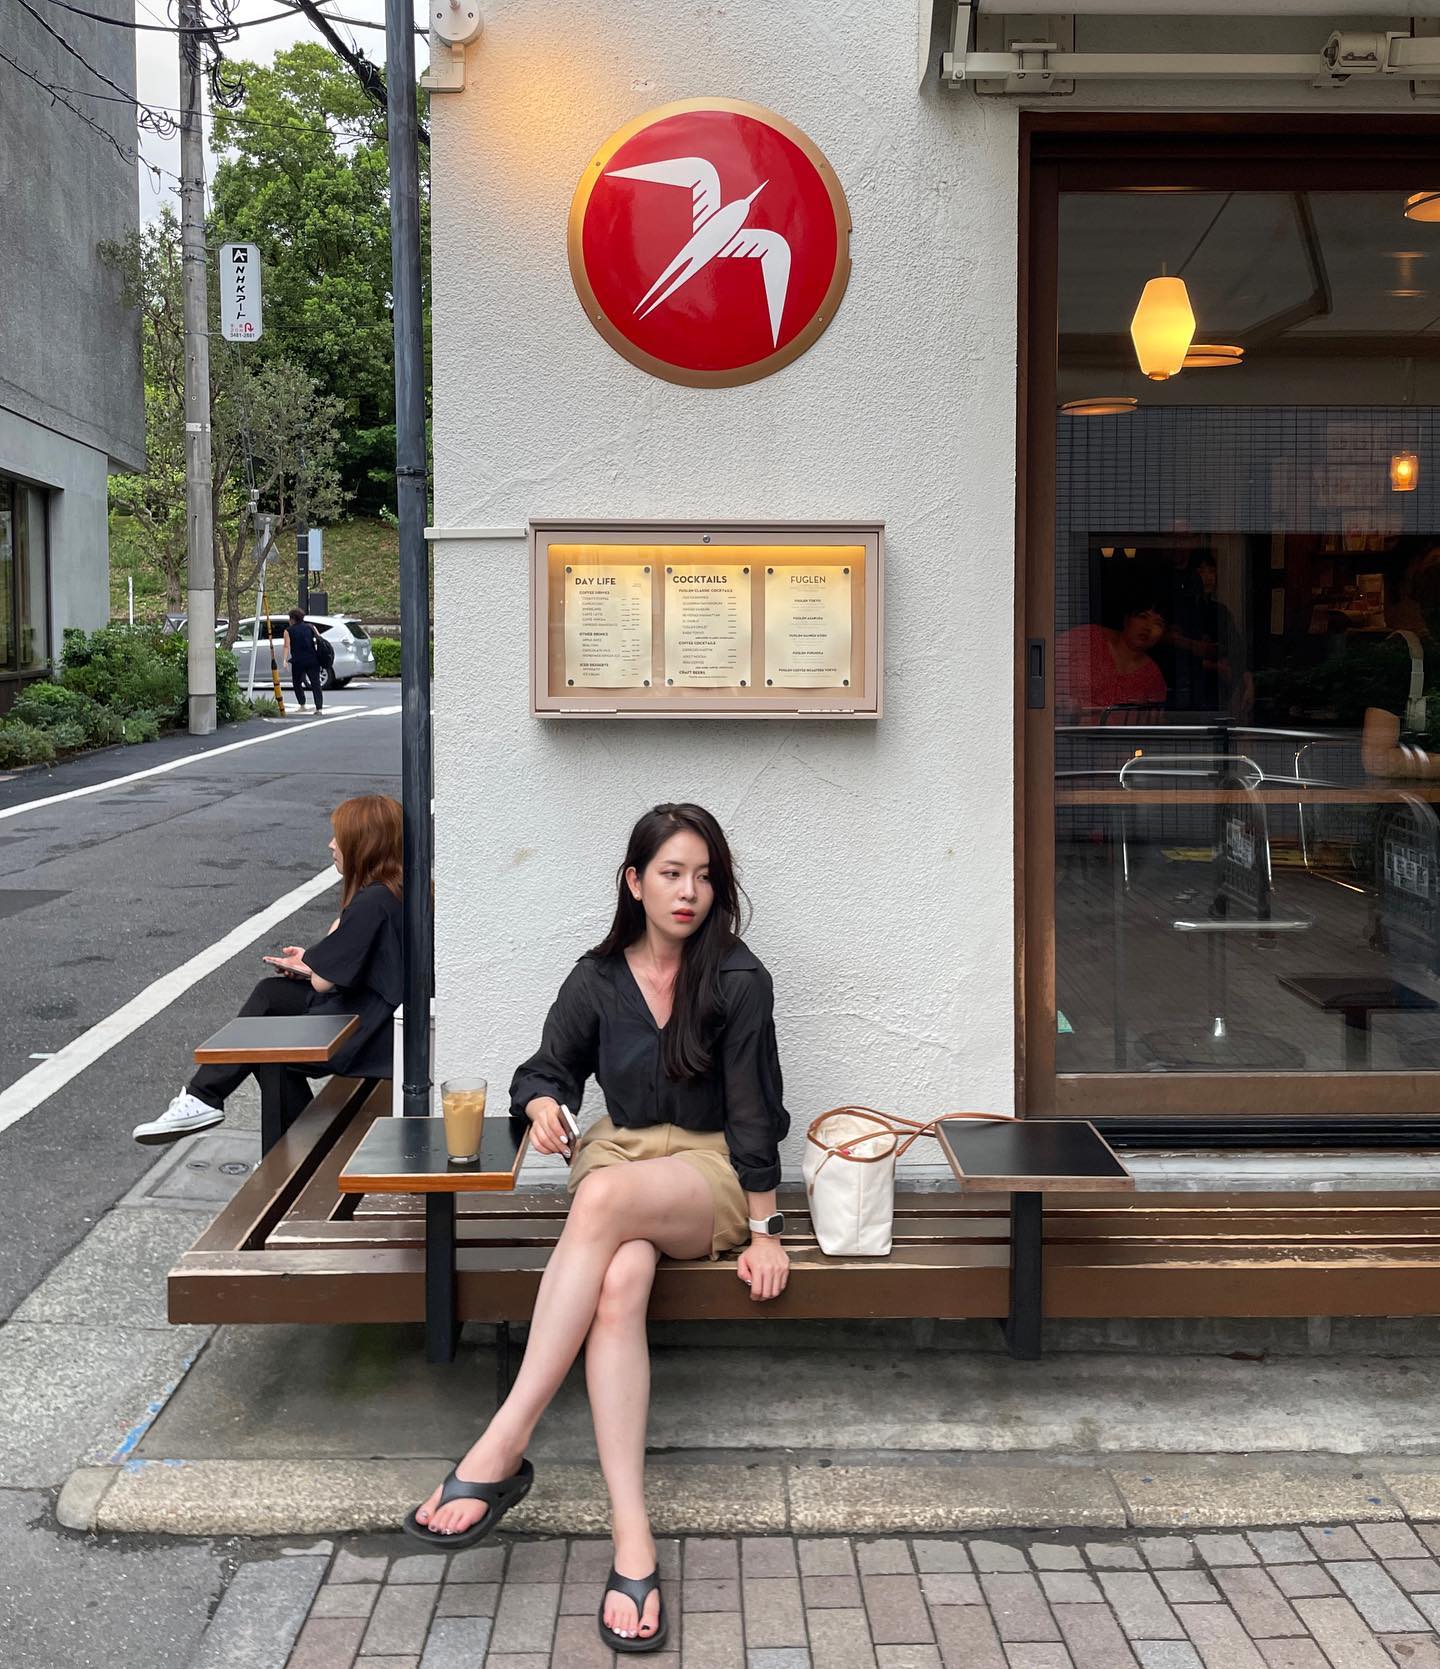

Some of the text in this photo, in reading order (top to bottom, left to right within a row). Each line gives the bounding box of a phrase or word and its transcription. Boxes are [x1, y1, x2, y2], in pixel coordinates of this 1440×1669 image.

[235, 266, 246, 320] NHKアート
[575, 578, 616, 586] DAY LIFE
[673, 576, 727, 584] COCKTAILS
[790, 576, 826, 584] FUGLEN
